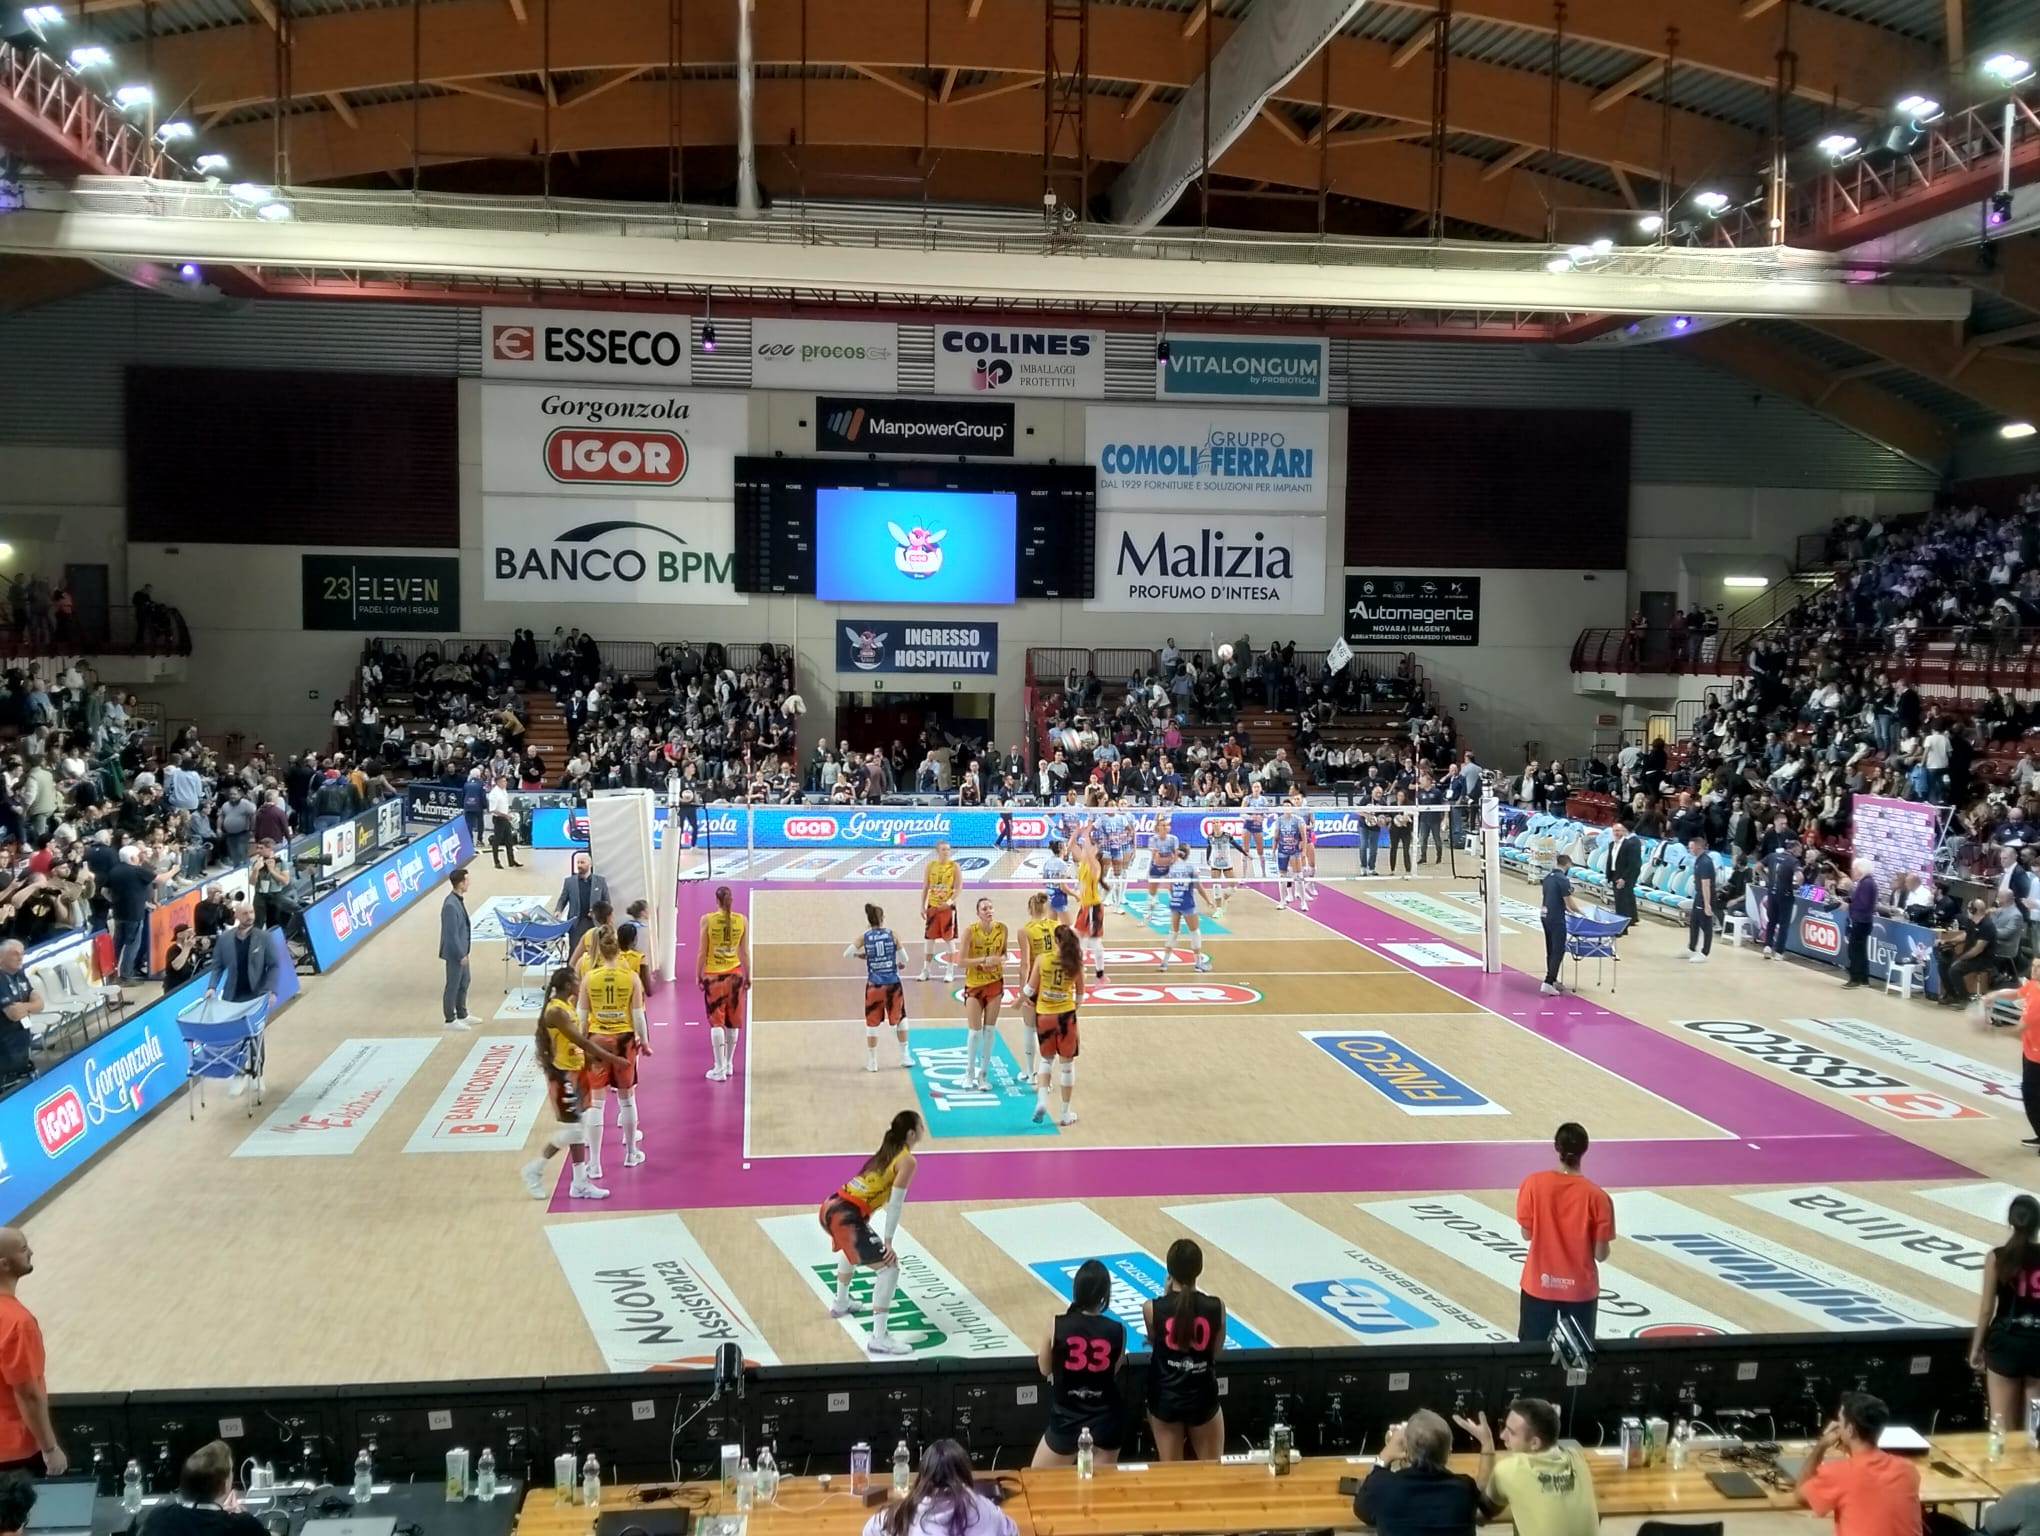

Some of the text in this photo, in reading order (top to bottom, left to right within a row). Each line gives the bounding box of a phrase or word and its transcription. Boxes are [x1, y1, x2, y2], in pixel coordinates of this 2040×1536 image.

[545, 327, 681, 366] ESSECO
[801, 341, 865, 362] procos
[942, 331, 1091, 356] COLINES
[1020, 364, 1076, 375] IMBALLAGGI
[1169, 355, 1318, 376] VITALONGUM
[1020, 377, 1076, 388] PROTETTIVI
[1250, 376, 1317, 385] by PROBIOTICAL
[541, 395, 690, 422] Gorgonzola
[869, 418, 1005, 441] ManpowerGroup
[1211, 431, 1285, 448] GRUPPO
[561, 439, 671, 474] IGOR
[1101, 444, 1313, 478] COMOLI FERRARI
[1101, 479, 1118, 489] DAL
[1121, 480, 1142, 490] 1929
[1144, 480, 1195, 491] FORNITURE
[1204, 481, 1253, 492] SOLUZIONI
[1256, 483, 1271, 493] PER
[1273, 483, 1312, 493] IMPIANTI
[1116, 529, 1294, 579] Malizia
[495, 548, 736, 584] BANCO BPM
[323, 577, 439, 601] 23 ELEVEN
[1129, 584, 1280, 600] PROFUMO D'INTESA
[359, 605, 439, 615] PADEL GYM REHAB
[1349, 601, 1474, 623] Automagenta
[905, 628, 980, 646] INGRESSO
[1412, 625, 1450, 633] MAGENTA
[895, 650, 990, 668] HOSPITALITY
[790, 812, 950, 839] IGOR Gorgonzola
[1011, 821, 1043, 835] GOR
[1805, 924, 1836, 947] IGOR
[604, 985, 614, 1004] 11
[1684, 1021, 1912, 1089] ESSECO
[445, 1043, 516, 1121] BANFI CONSULTING
[1337, 1040, 1463, 1101] FINECO
[41, 1026, 164, 1145] IGOR Gorgonzola
[652, 1260, 739, 1339] Assistenza
[1344, 1249, 1489, 1330] PREFABBRICATI
[593, 1266, 684, 1344] NUOVA
[899, 1254, 1009, 1351] Hydronic Solutions
[1064, 1335, 1112, 1372] 33
[1022, 1391, 1034, 1400] D7
